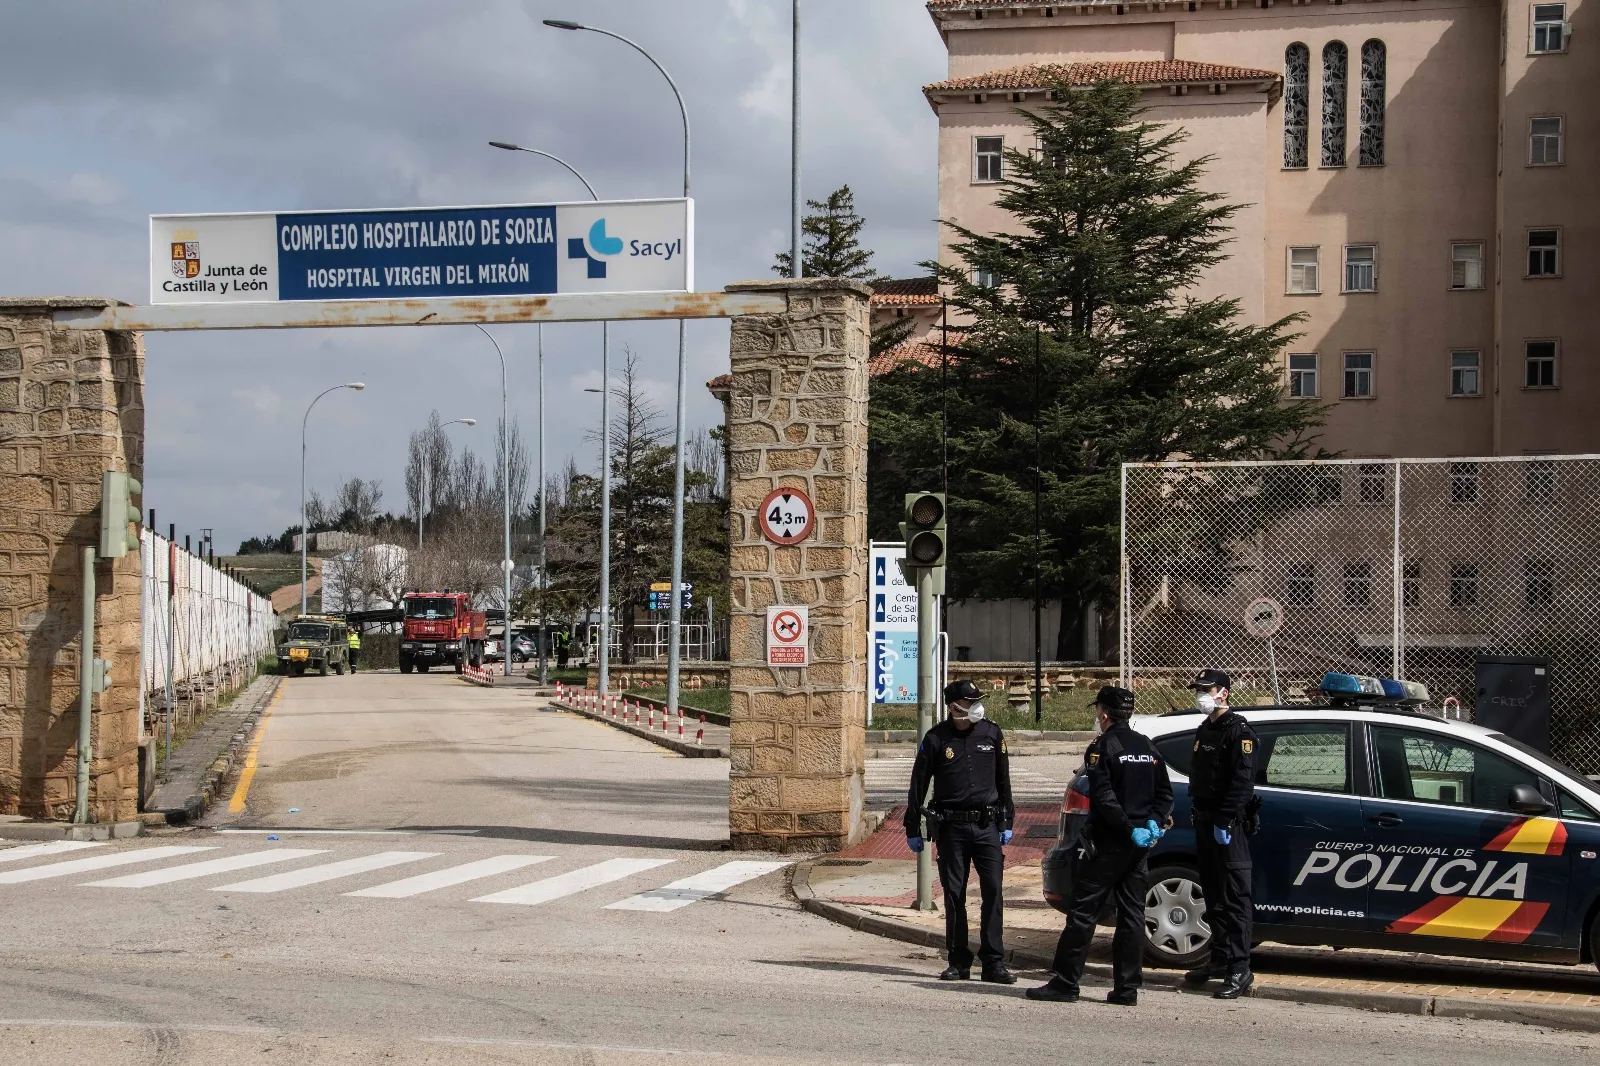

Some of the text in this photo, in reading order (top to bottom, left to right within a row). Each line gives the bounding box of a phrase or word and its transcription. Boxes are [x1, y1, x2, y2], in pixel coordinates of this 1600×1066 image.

[281, 217, 554, 251] COMPLEJO HOSPITALARIO DE SORIA
[629, 238, 681, 260] Sacyl
[204, 264, 267, 277] Junta de
[307, 257, 529, 288] HOSPITAL VIRGEN DEL MIRÓN
[162, 279, 268, 294] Castilla y León
[891, 578, 905, 586] del
[895, 593, 918, 602] Centr
[891, 604, 918, 613] de Sal
[886, 614, 908, 623] Soria
[875, 638, 899, 700] Sacyl
[1119, 754, 1154, 764] POLICIA
[1315, 841, 1475, 857] CUERPO NACIONAL DE
[1293, 851, 1529, 899] POLICIA
[1253, 903, 1365, 918] www.policia.es
